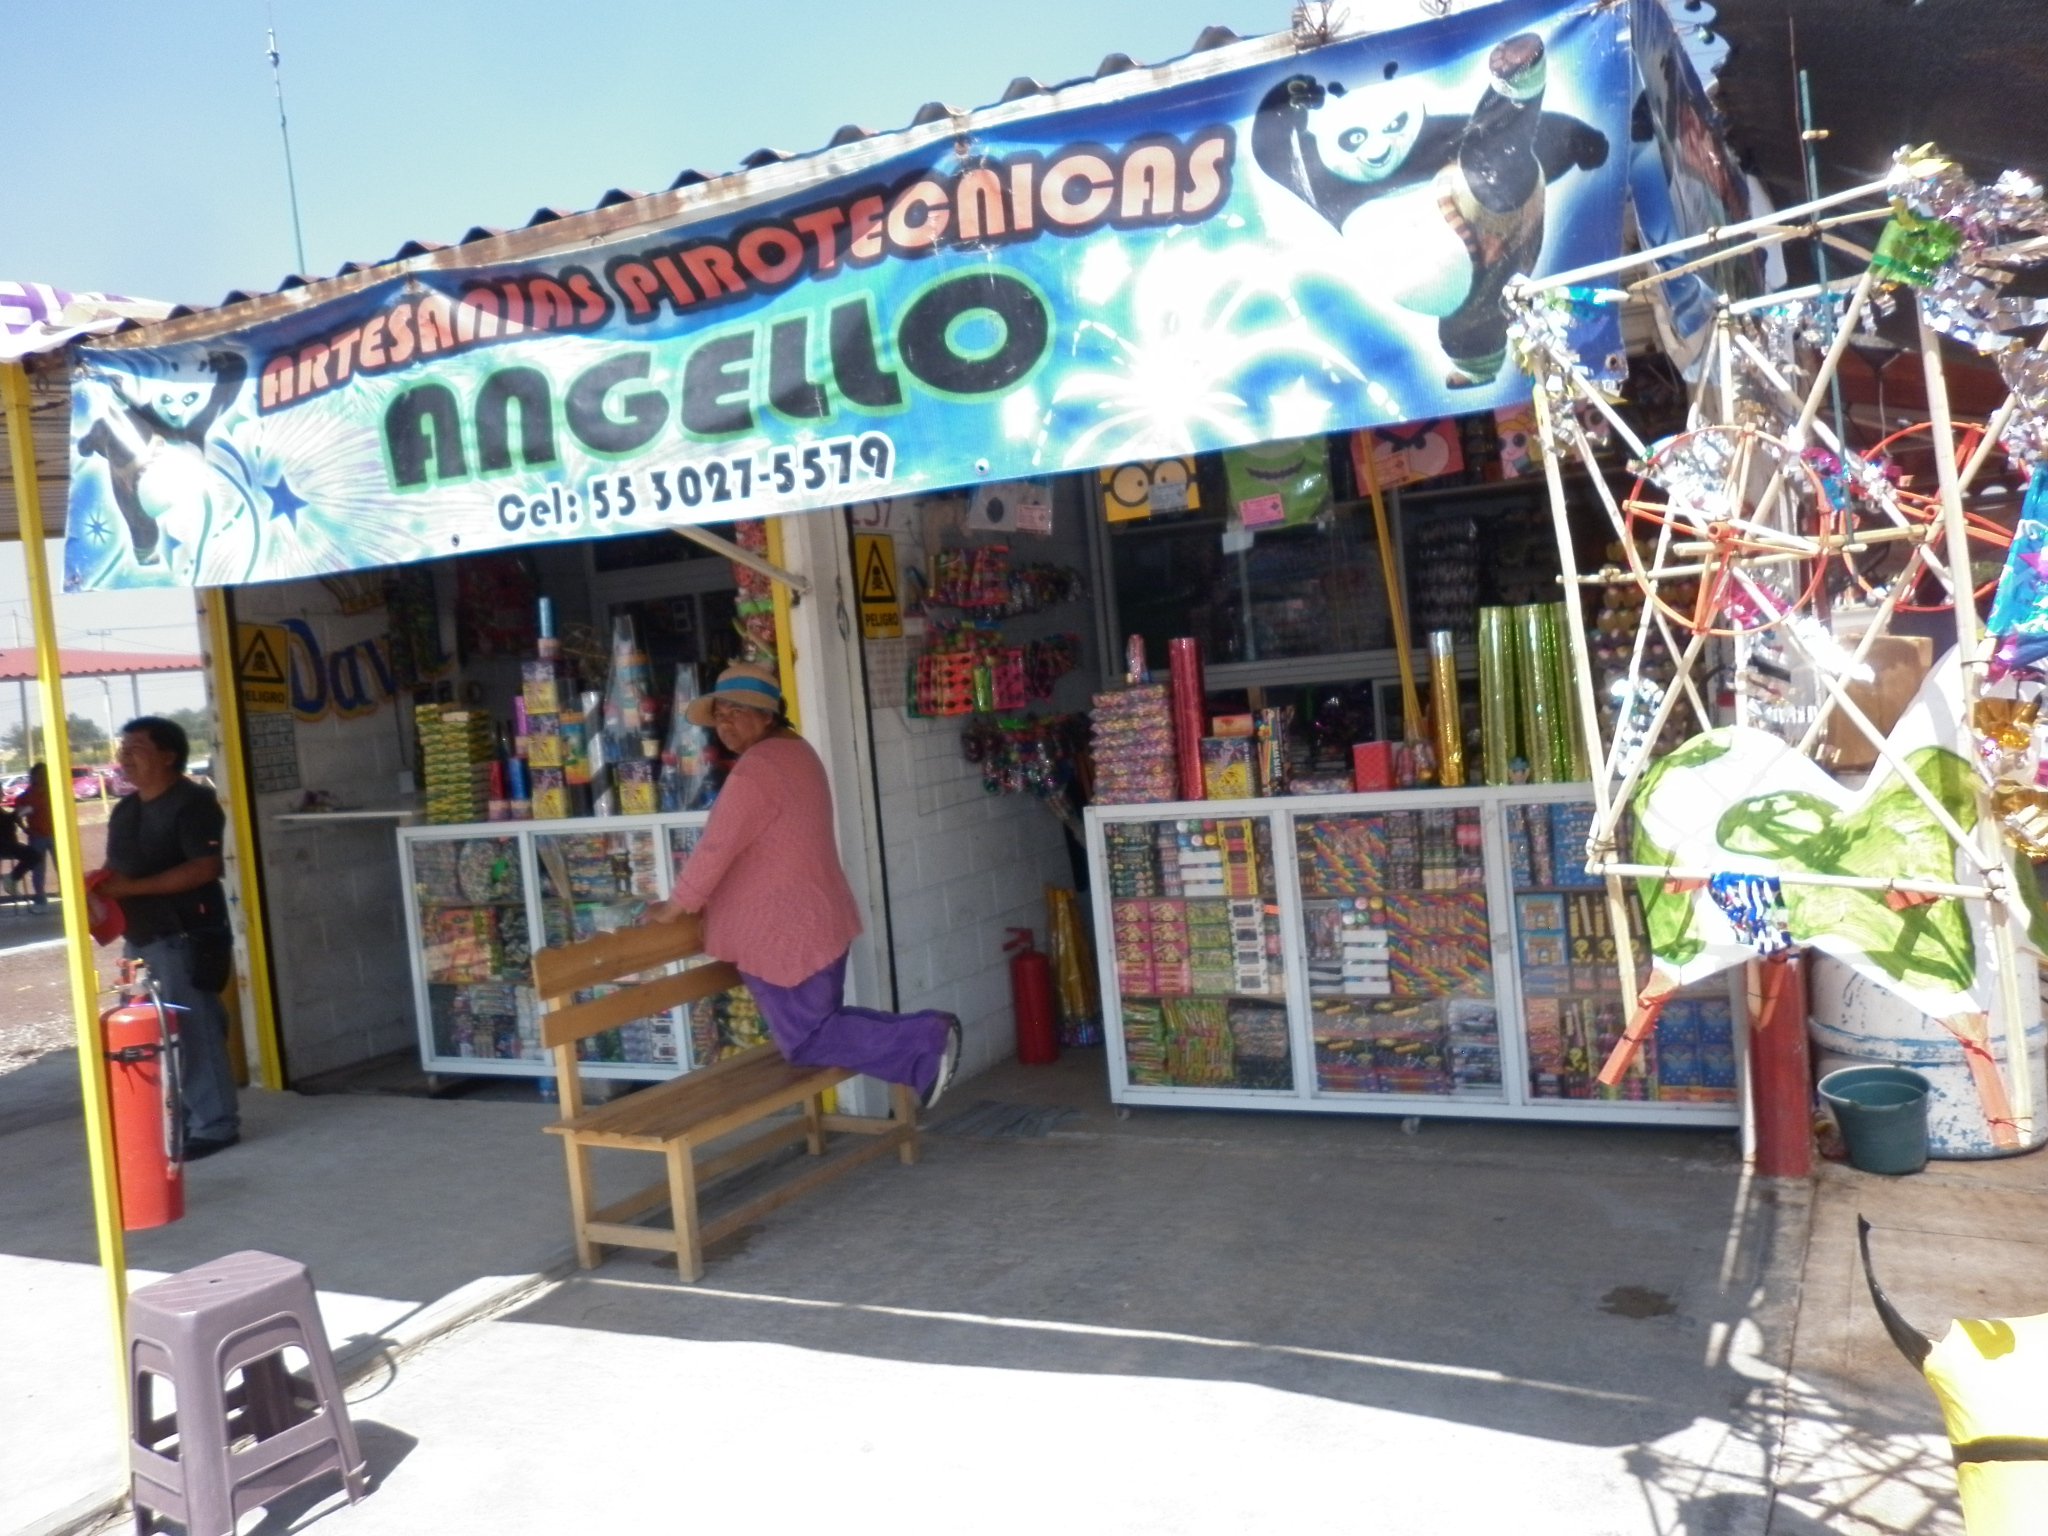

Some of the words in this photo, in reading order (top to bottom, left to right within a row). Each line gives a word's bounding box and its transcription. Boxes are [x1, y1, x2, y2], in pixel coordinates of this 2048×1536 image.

[259, 271, 609, 410] ARTESANIAS
[613, 136, 1226, 314] PIROTECNICAS
[383, 270, 1050, 489] ANGELLO
[498, 486, 578, 532] Cel:
[592, 475, 636, 520] 55
[650, 435, 891, 512] 3027-5579
[864, 612, 900, 627] PELIGRO
